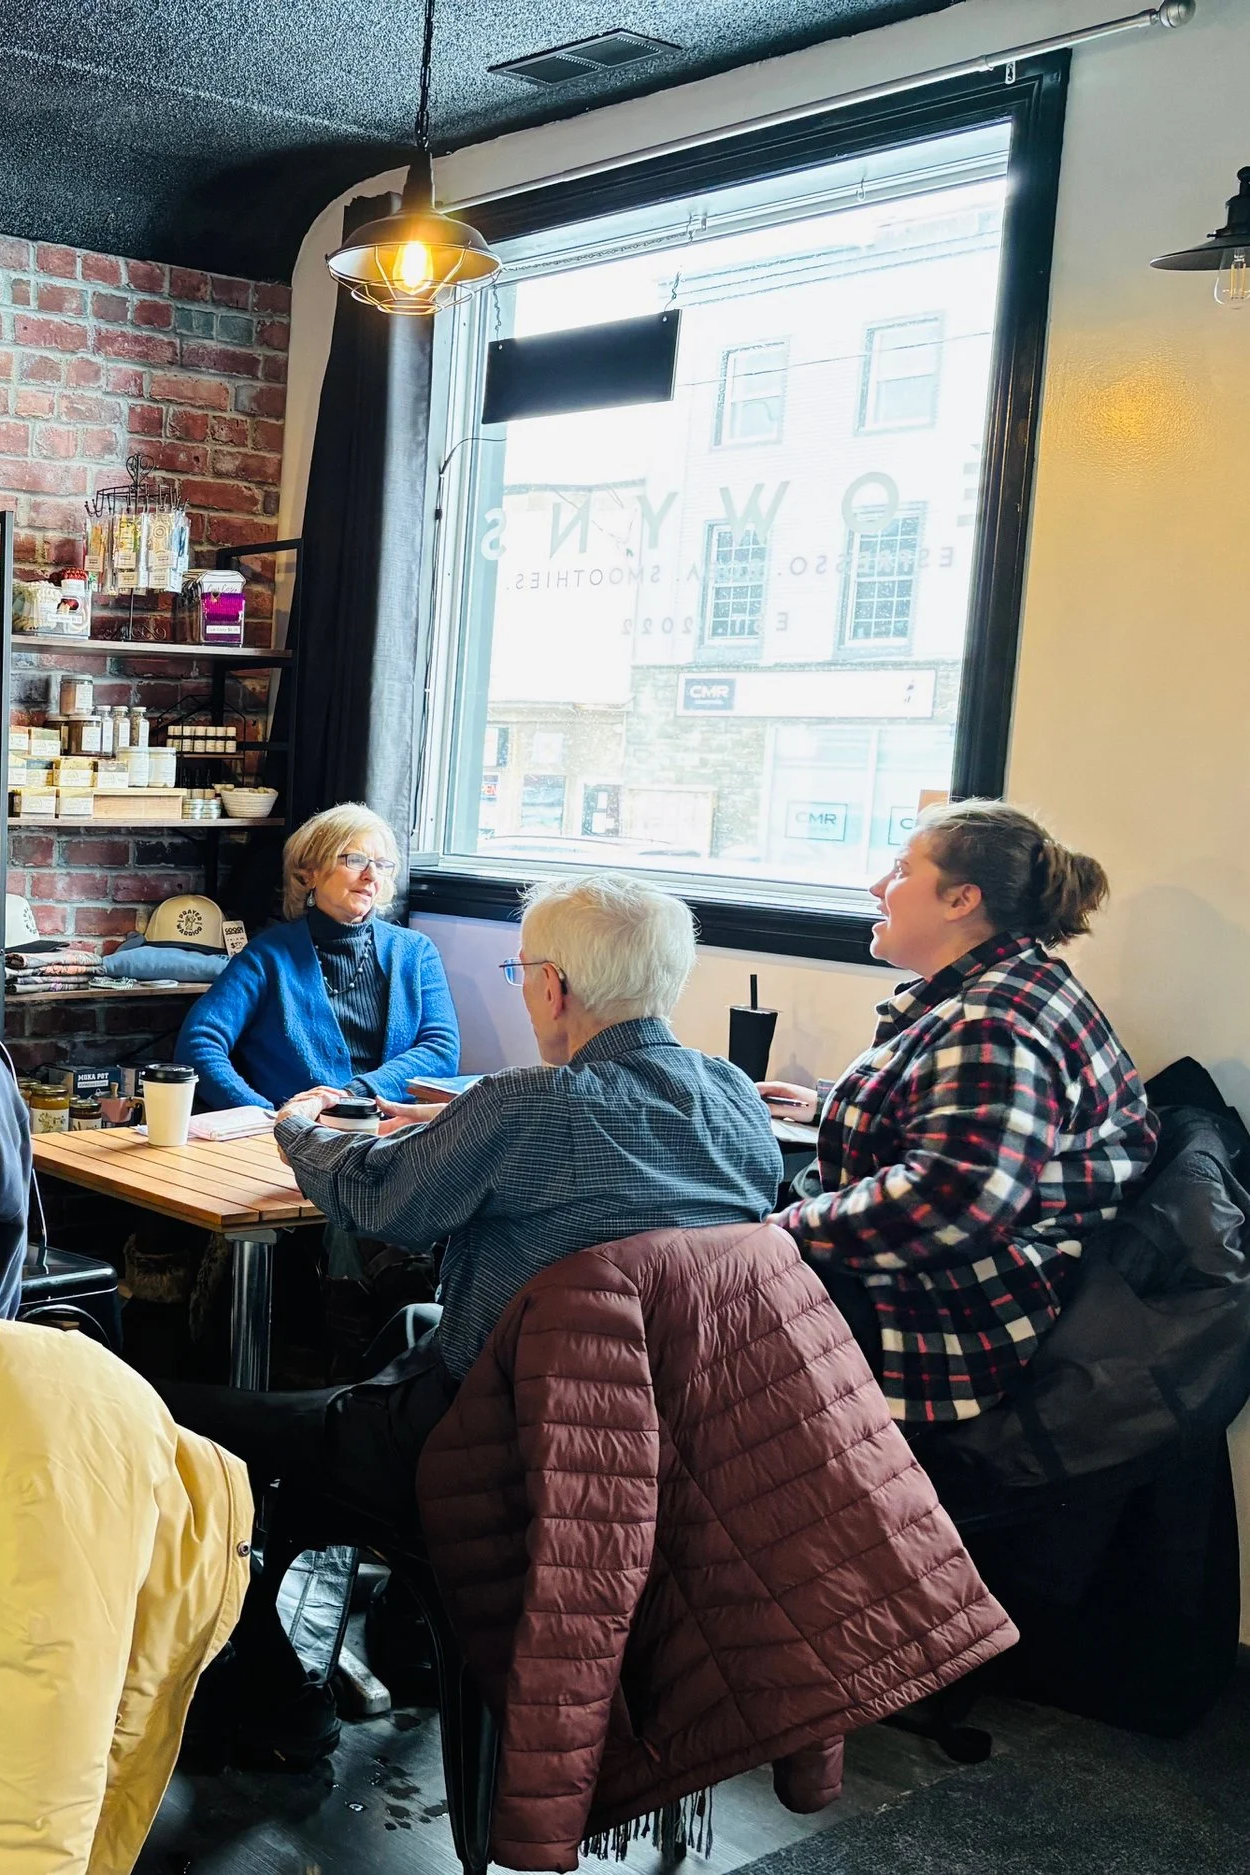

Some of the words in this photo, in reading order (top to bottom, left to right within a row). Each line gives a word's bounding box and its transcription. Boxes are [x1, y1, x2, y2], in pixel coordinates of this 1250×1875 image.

[689, 686, 730, 698] CMR
[795, 812, 838, 825] CMR
[179, 909, 202, 921] PRAYER
[176, 923, 203, 936] WARRIOR
[97, 1072, 109, 1080] POT
